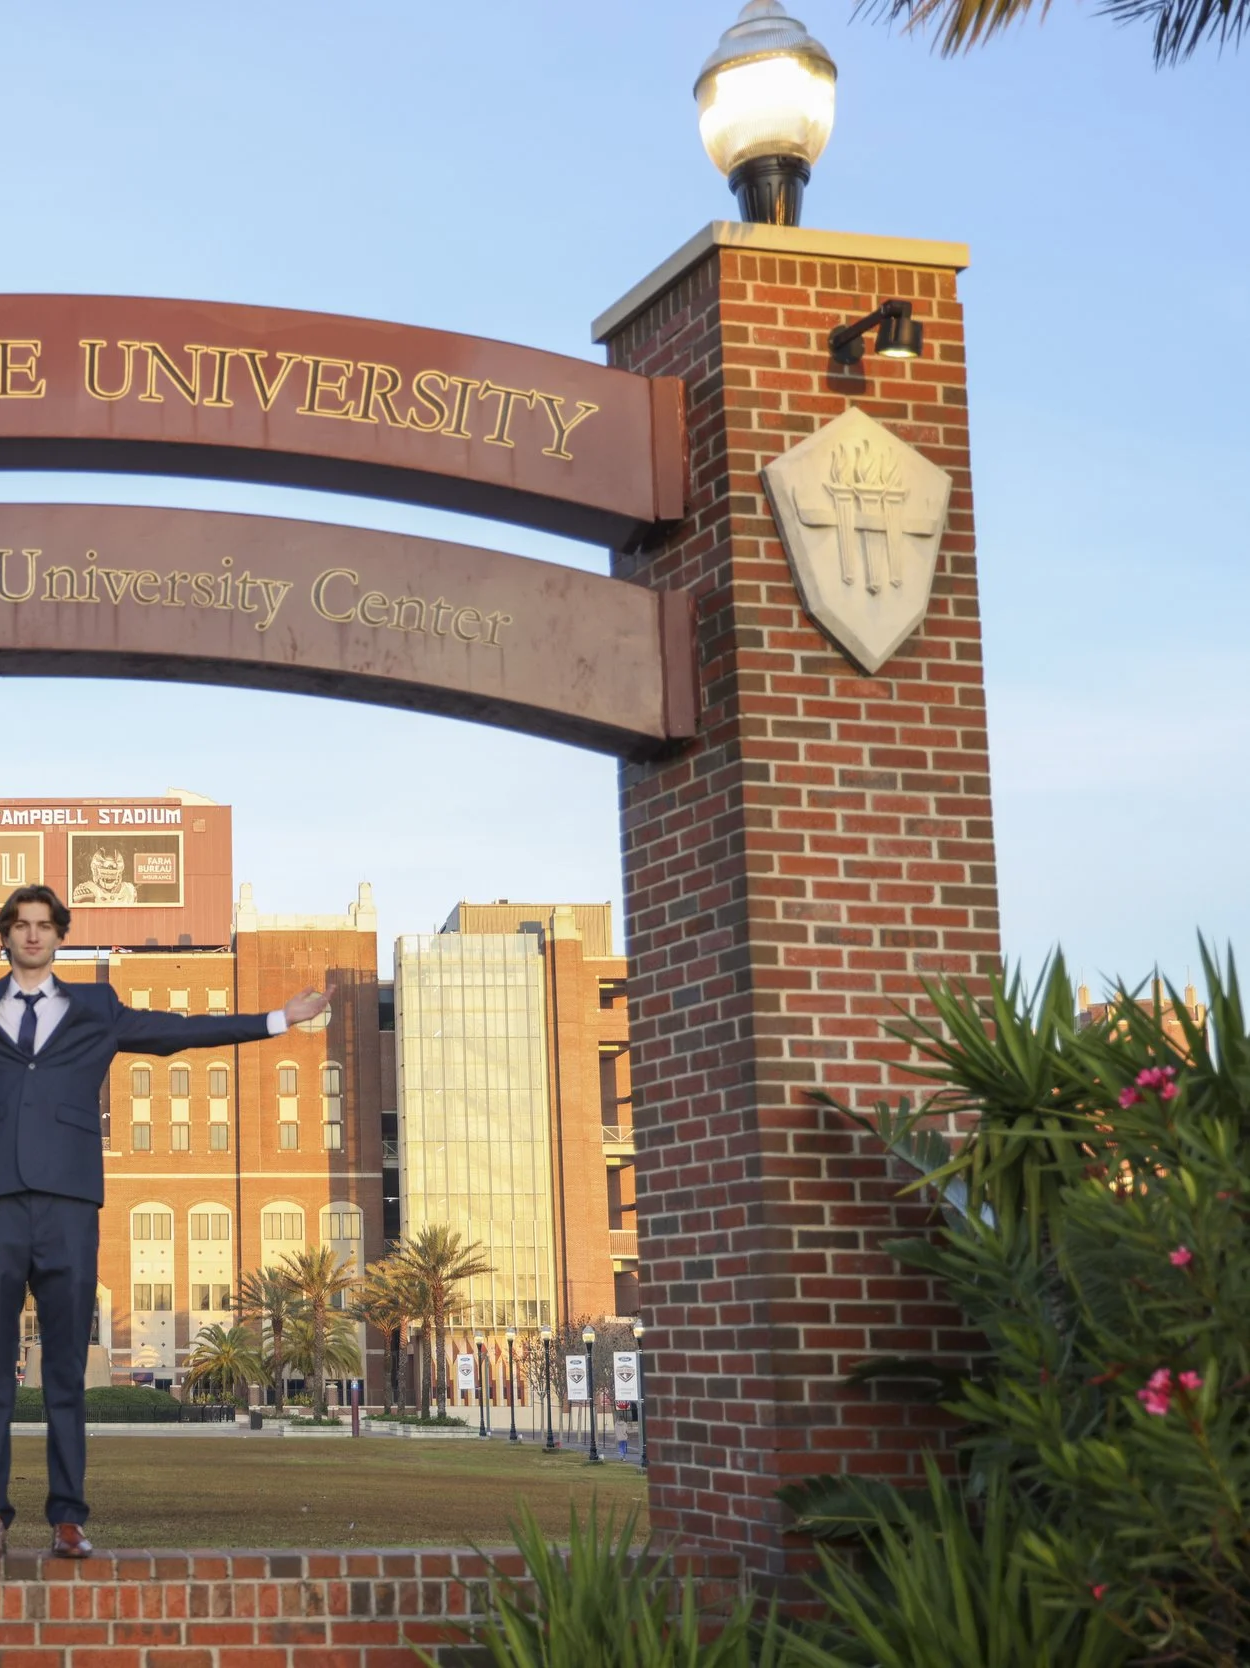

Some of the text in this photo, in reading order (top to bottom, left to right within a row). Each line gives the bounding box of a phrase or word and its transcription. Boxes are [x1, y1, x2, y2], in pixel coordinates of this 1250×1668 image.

[78, 339, 599, 461] UNIVERSITY
[309, 566, 514, 649] Center
[98, 807, 182, 825] STADIUM
[137, 864, 172, 873] BUREAU
[147, 856, 172, 865] FARM
